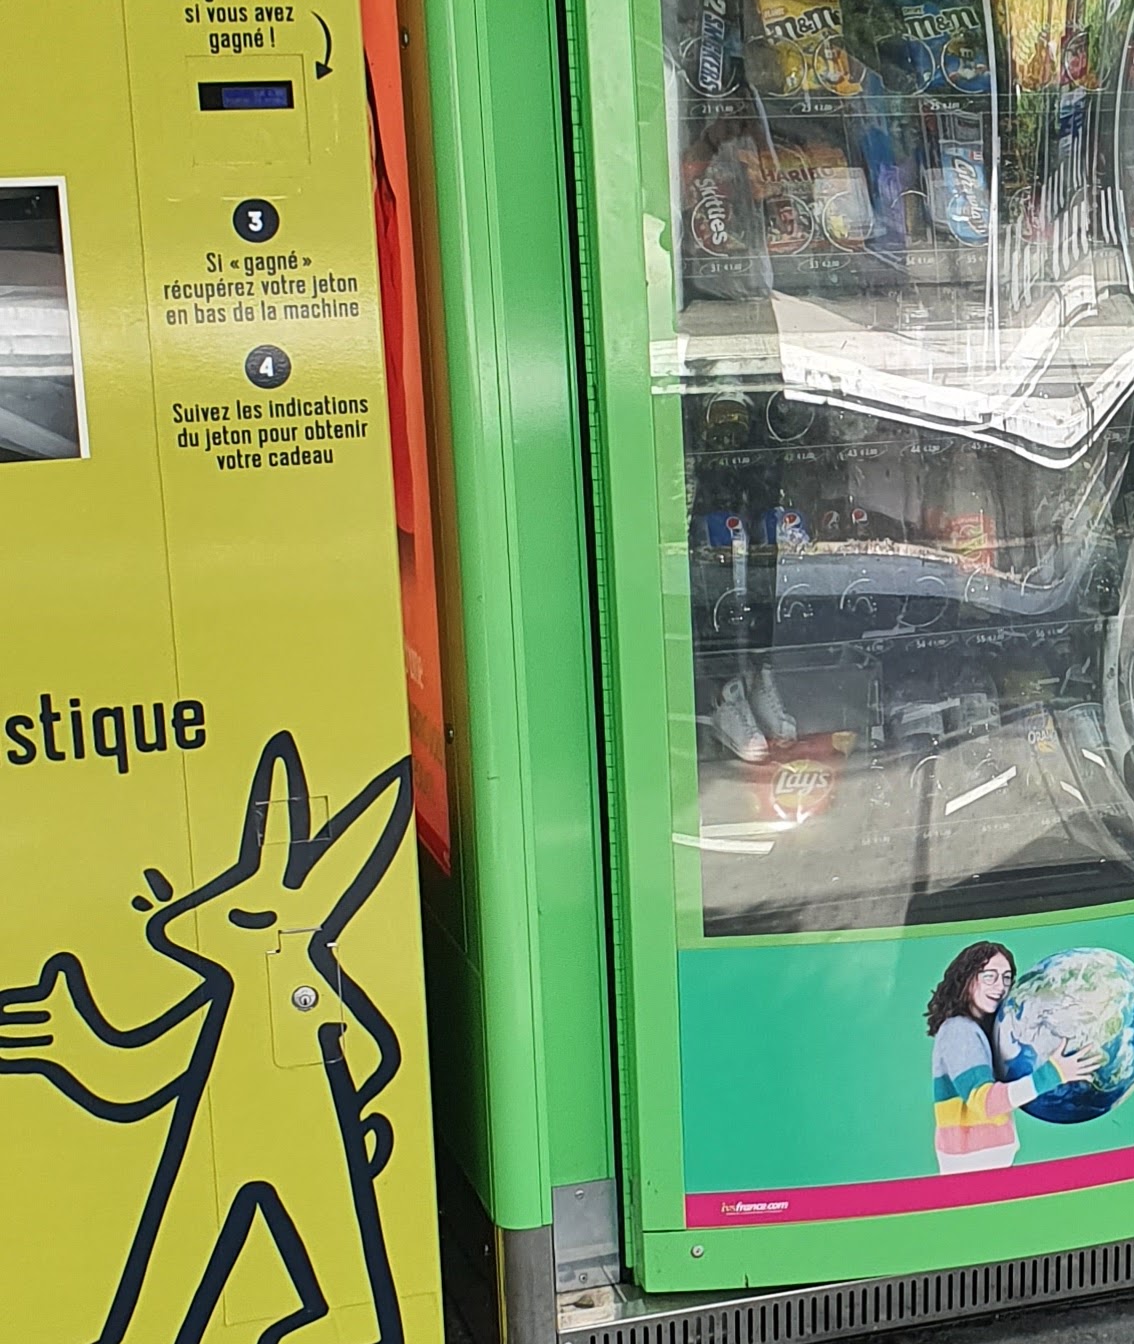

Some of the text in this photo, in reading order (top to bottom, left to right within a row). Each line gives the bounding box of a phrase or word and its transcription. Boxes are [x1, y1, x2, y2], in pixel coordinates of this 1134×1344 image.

[185, 4, 295, 23] si vous avez
[209, 26, 275, 54] gagné !
[247, 211, 263, 232] 3
[206, 252, 223, 273] Si
[244, 250, 298, 276] gagné
[164, 272, 358, 303] récupérez votre jeton
[167, 298, 360, 326] en bas de la machine
[258, 356, 274, 377] 4
[172, 395, 369, 424] Suivez les indications
[177, 419, 369, 452] du jeton pour obtenir
[217, 445, 334, 471] votre cadeau
[4, 693, 207, 774] stique
